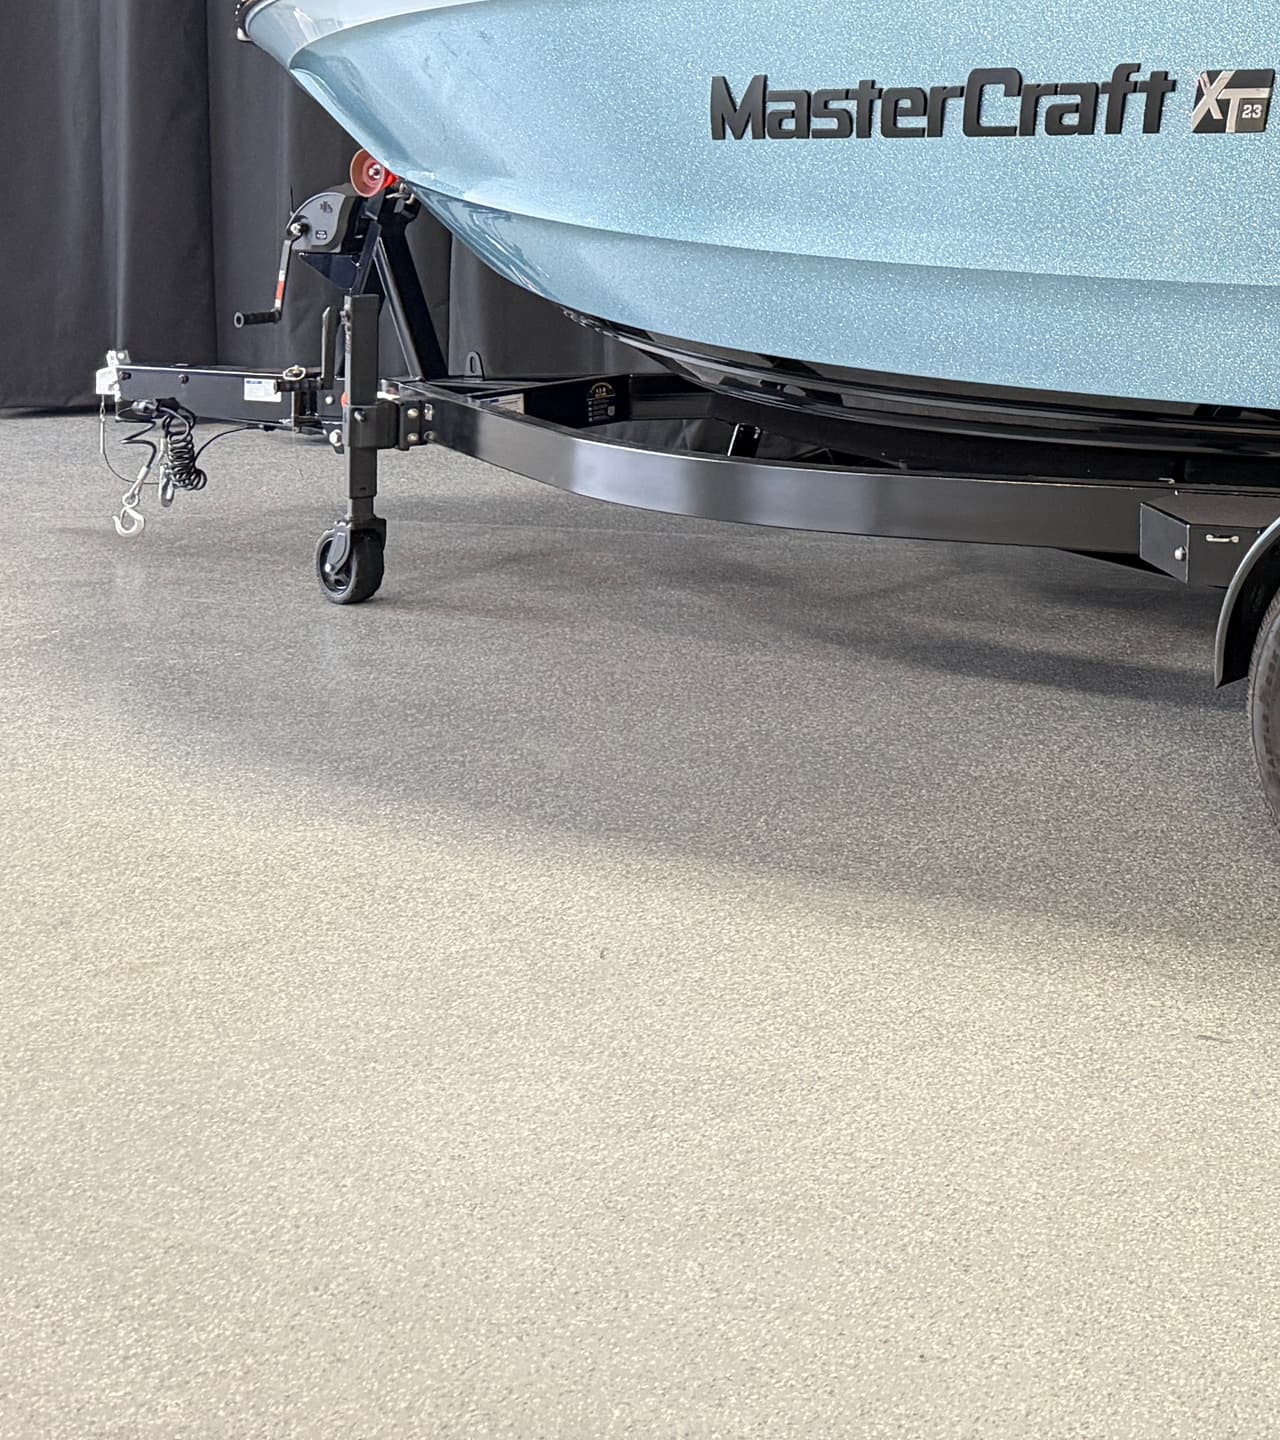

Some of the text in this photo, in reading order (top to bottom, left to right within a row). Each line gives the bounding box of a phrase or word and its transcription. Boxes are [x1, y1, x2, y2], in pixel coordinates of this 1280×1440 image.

[710, 63, 1271, 140] MasterCraft XT
[1241, 103, 1263, 119] 23
